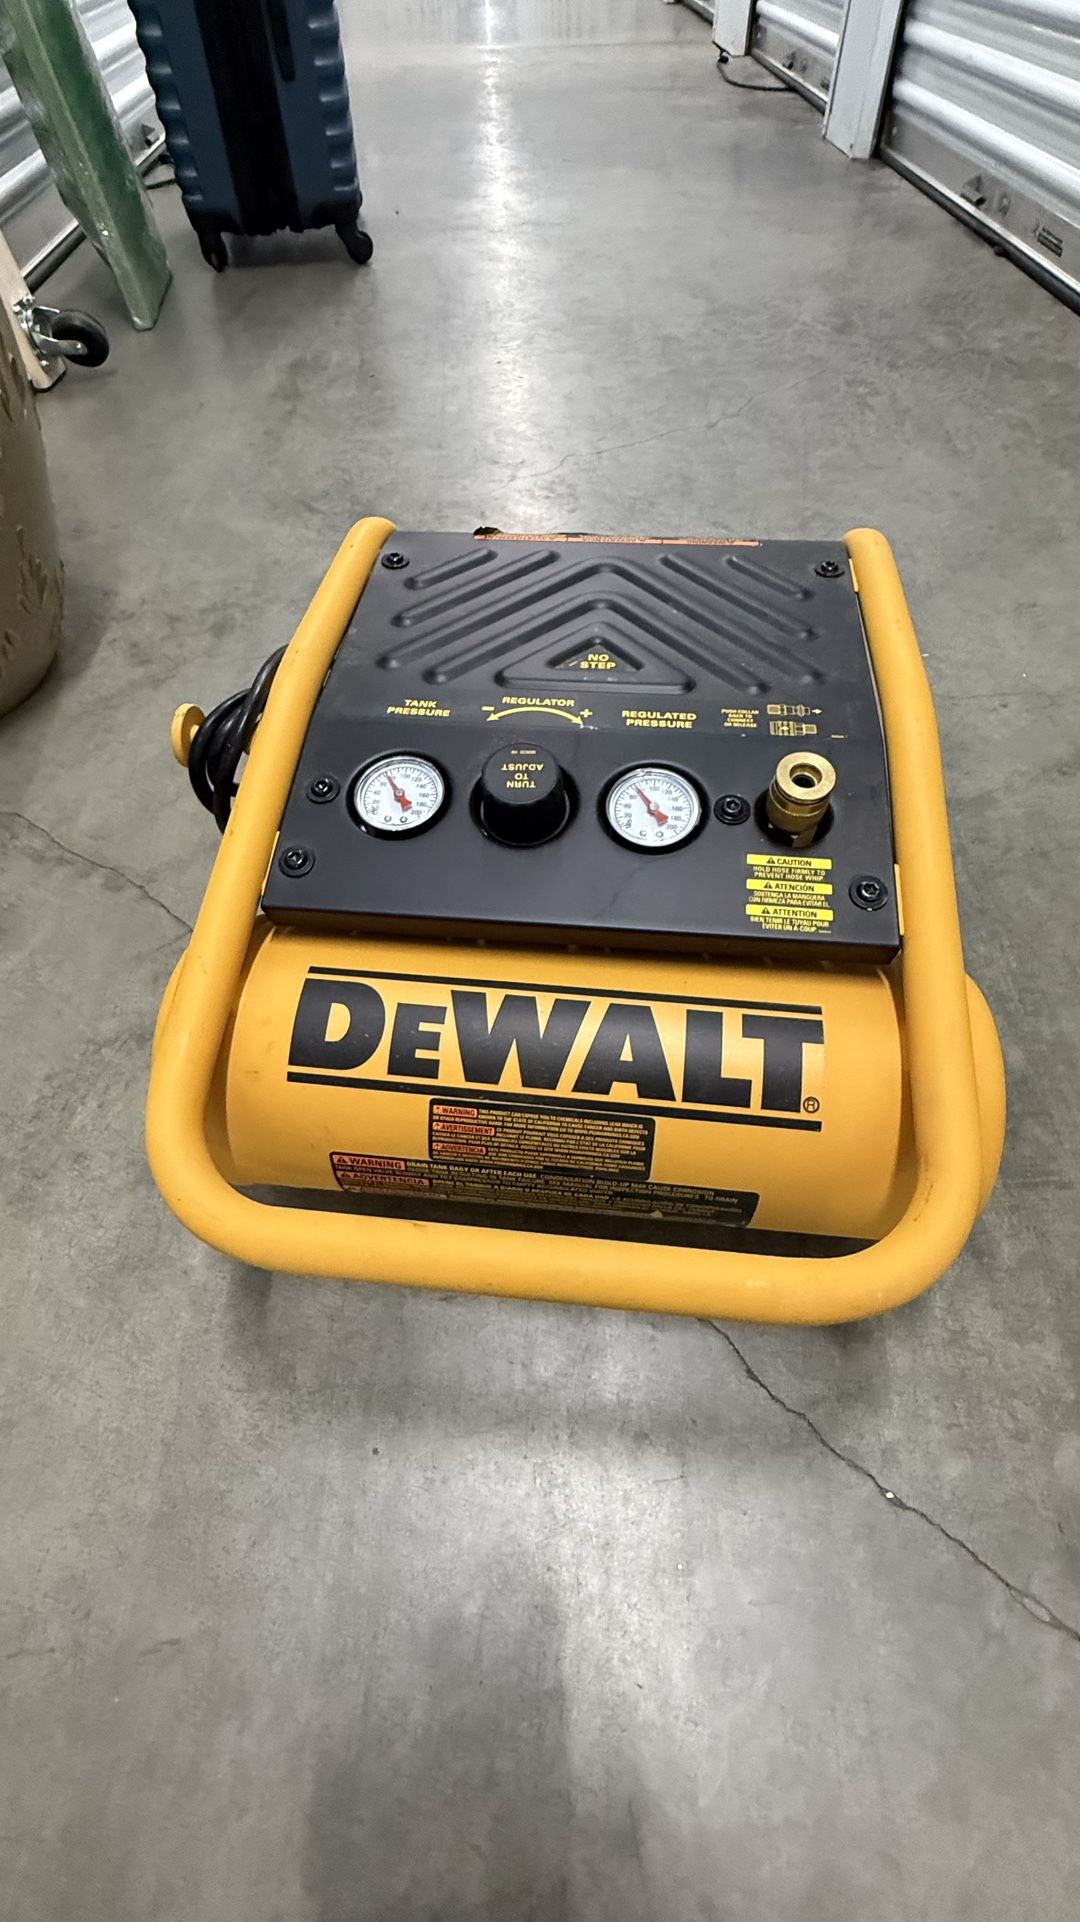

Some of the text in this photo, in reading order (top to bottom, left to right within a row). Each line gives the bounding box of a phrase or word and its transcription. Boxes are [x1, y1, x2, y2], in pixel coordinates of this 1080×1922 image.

[580, 661, 616, 670] STEP
[405, 699, 437, 707] TANK
[502, 696, 575, 707] REGULATOR
[386, 706, 451, 717] PRESSURE
[622, 710, 696, 720] REGULATED
[626, 719, 693, 728] PRESSURE
[775, 883, 814, 891] ATENCIÓN
[773, 909, 817, 917] ATTENTION
[288, 977, 824, 1112] DEWALT
[442, 1107, 475, 1116] WARNING
[442, 1123, 493, 1135] AVERTISSEMENT
[349, 1157, 402, 1168] WARNING
